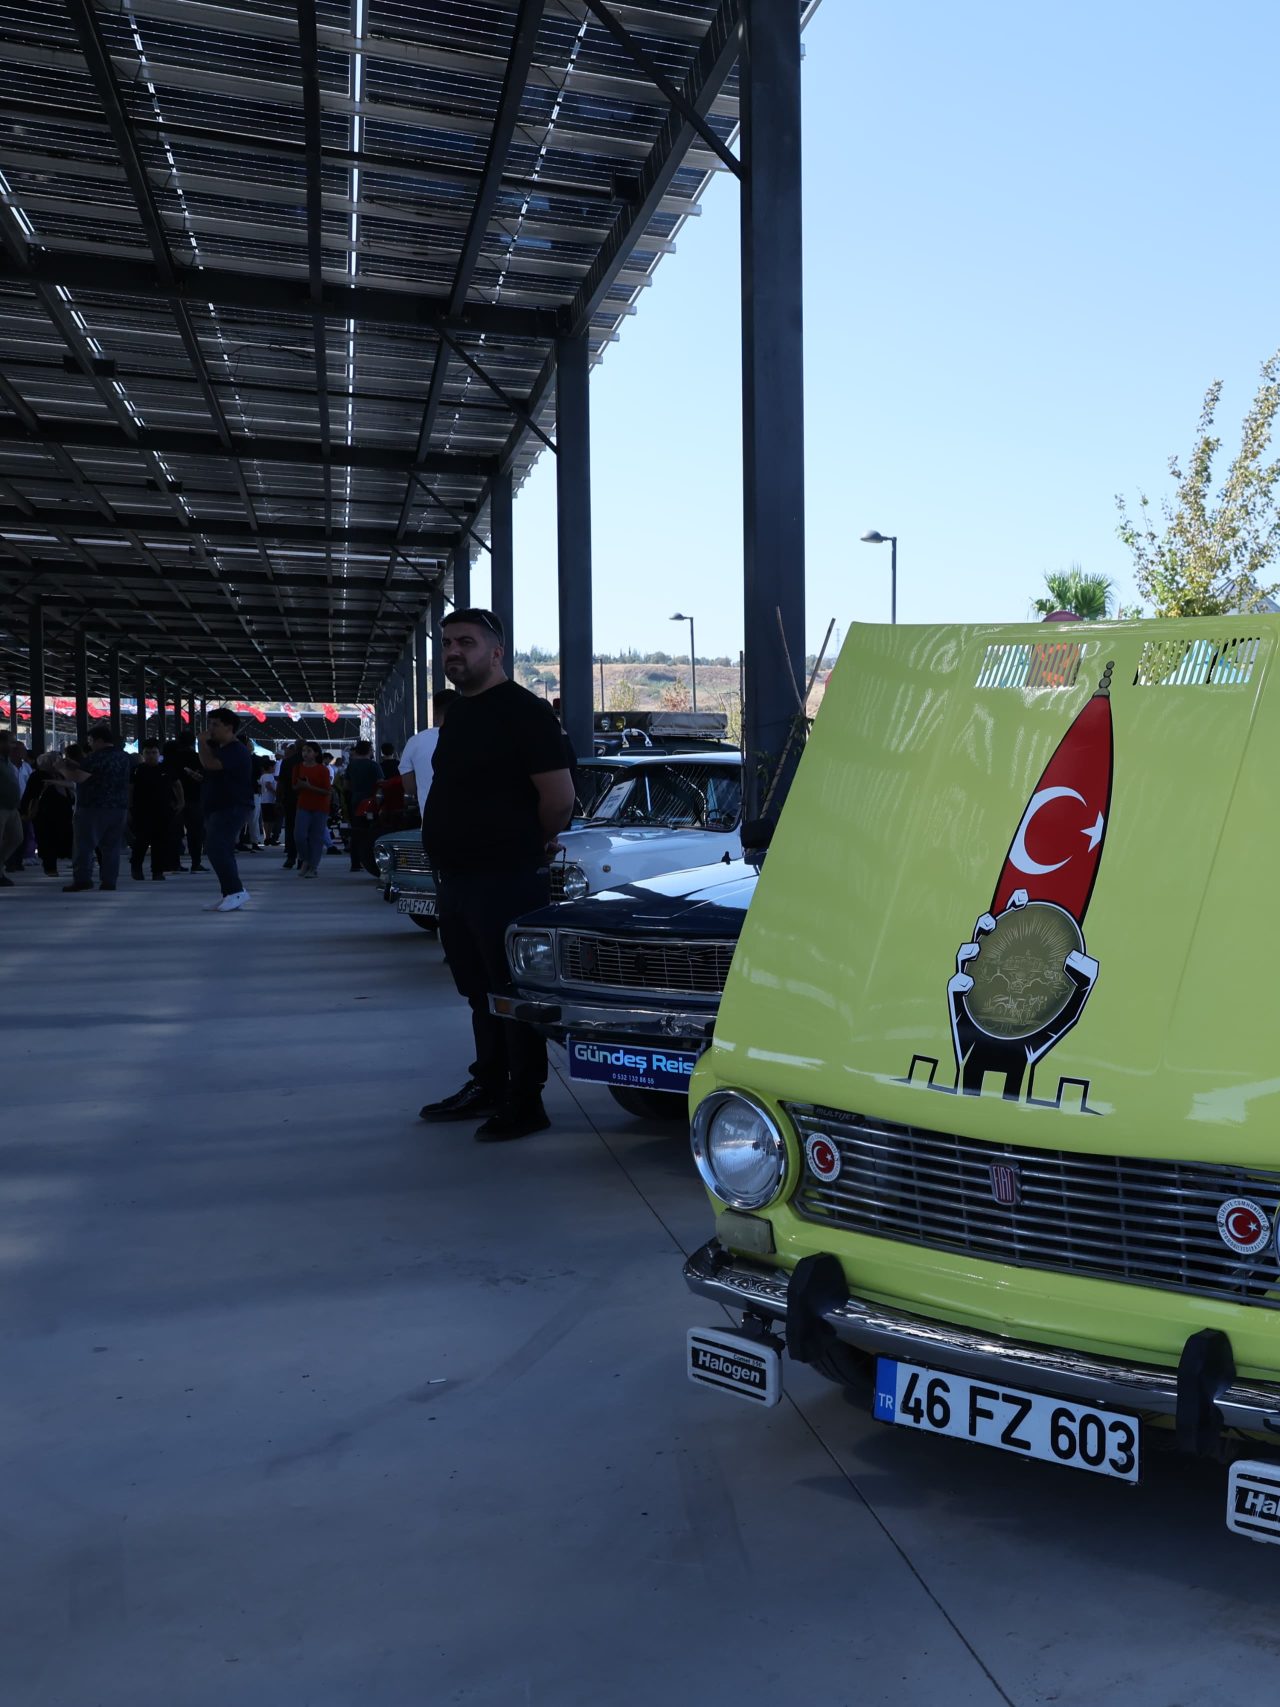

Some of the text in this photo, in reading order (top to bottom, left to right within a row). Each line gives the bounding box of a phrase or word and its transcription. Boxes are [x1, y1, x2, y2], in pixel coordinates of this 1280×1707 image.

[574, 1044, 695, 1075] Gündeş Reis
[993, 1166, 1012, 1201] FIAT
[698, 1350, 760, 1384] Halogen
[878, 1393, 894, 1411] TR
[901, 1373, 1135, 1474] 46 FZ 603
